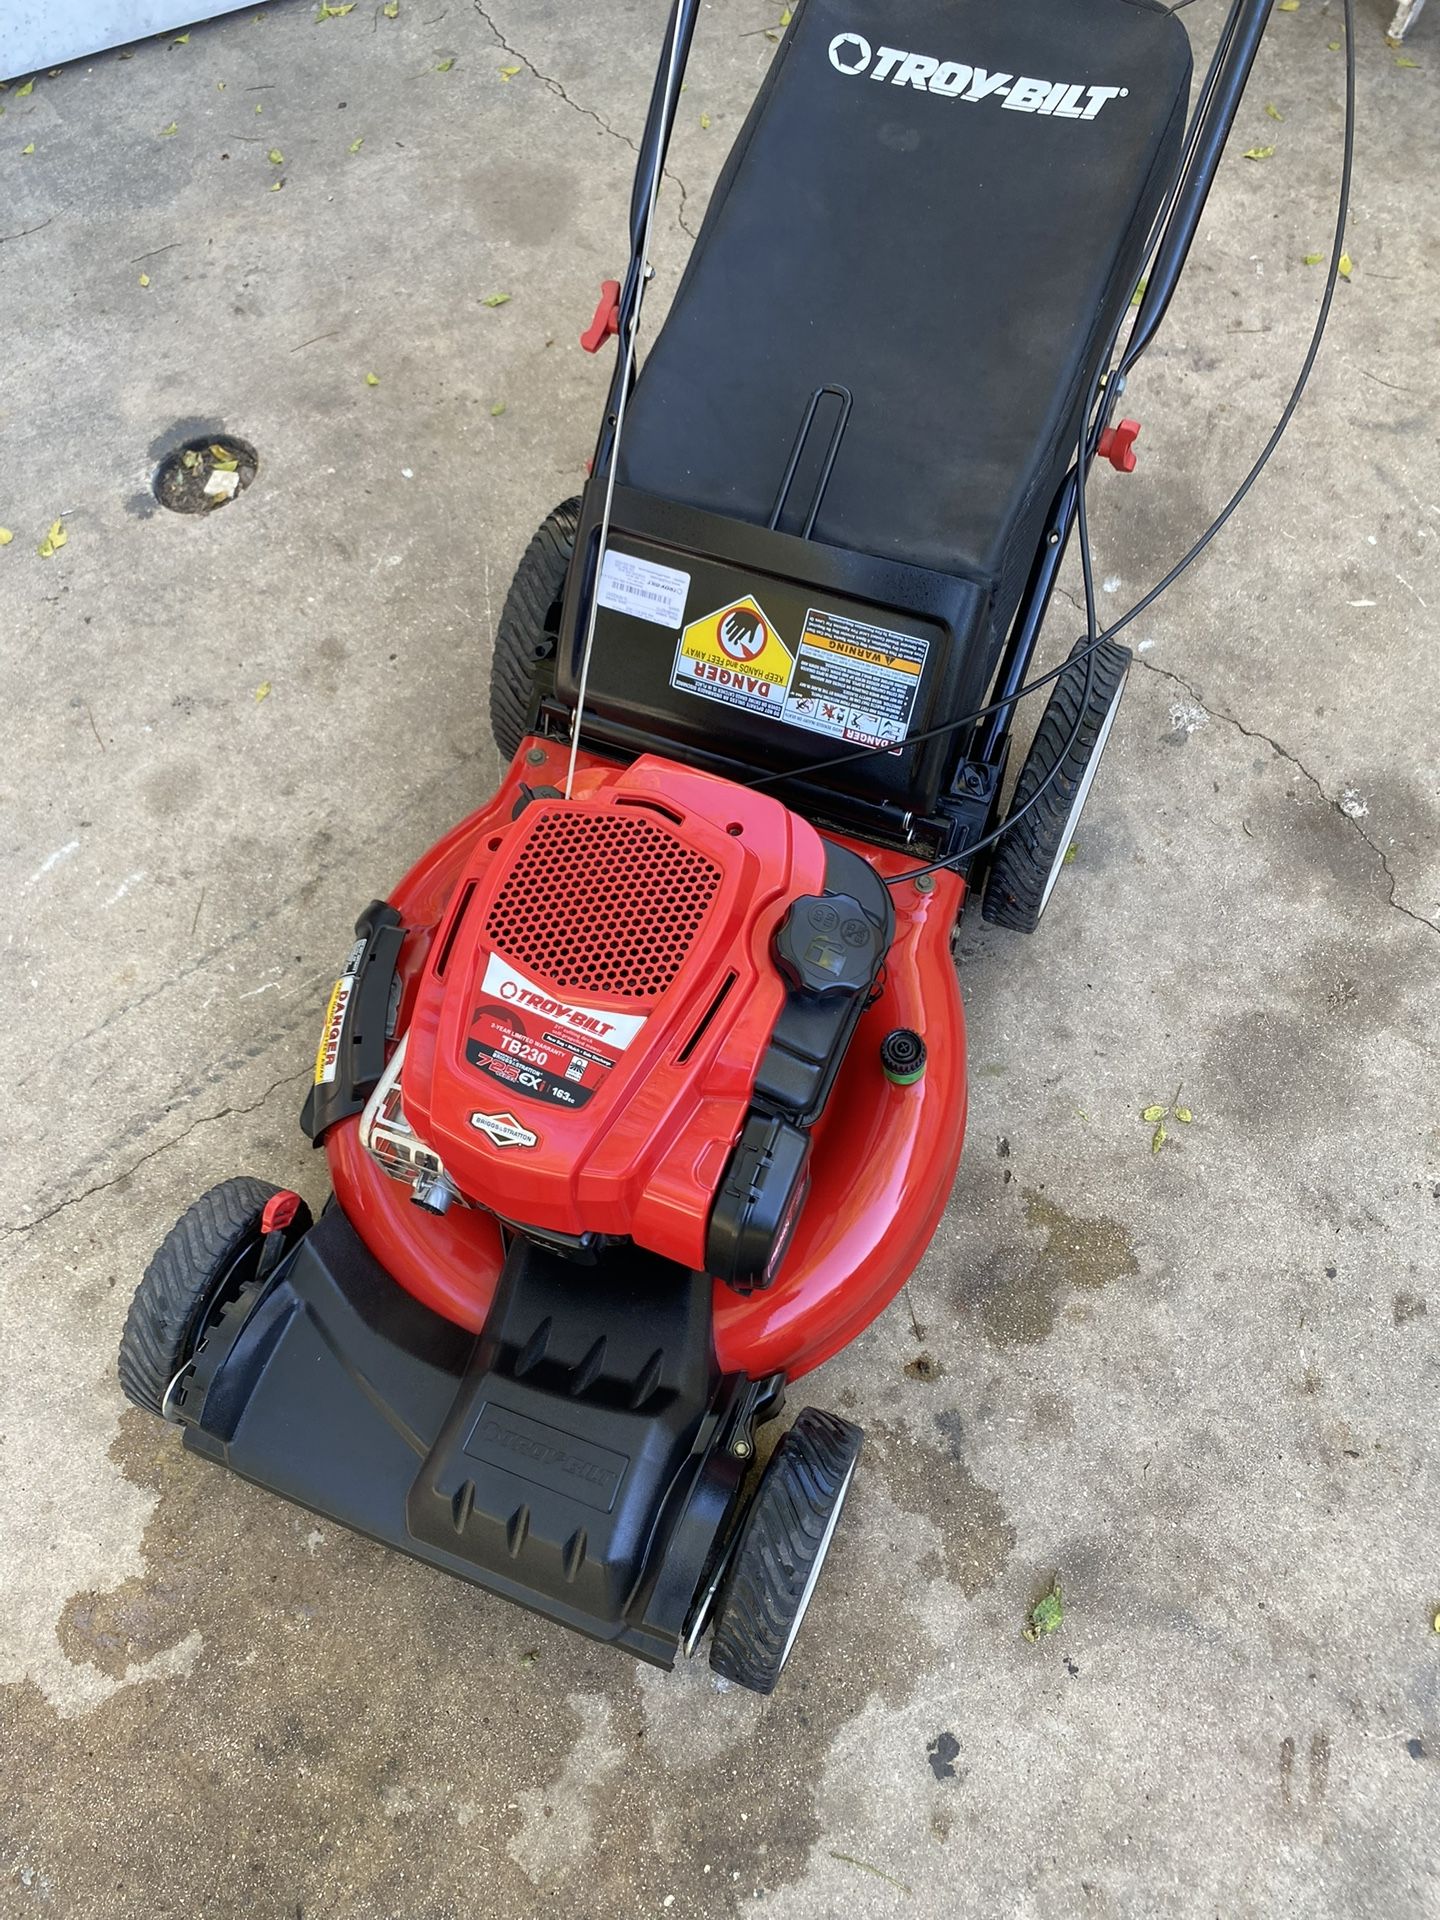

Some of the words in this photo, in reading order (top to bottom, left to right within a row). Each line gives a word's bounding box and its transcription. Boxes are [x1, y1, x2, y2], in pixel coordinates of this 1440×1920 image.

[871, 46, 1118, 121] TROY-BILT
[684, 646, 706, 659] AWAY
[706, 653, 724, 665] FEET
[827, 640, 881, 662] WARNING
[724, 659, 738, 669] and
[738, 663, 763, 677] HANDS
[691, 661, 771, 697] DANGER
[764, 671, 783, 683] KEEP
[845, 729, 889, 748] DANGER
[515, 987, 614, 1039] TROY-BILT
[324, 989, 348, 1066] DANGER
[497, 1034, 549, 1066] TB230
[510, 1030, 534, 1044] LIMITED
[533, 1040, 565, 1058] WARRANTY
